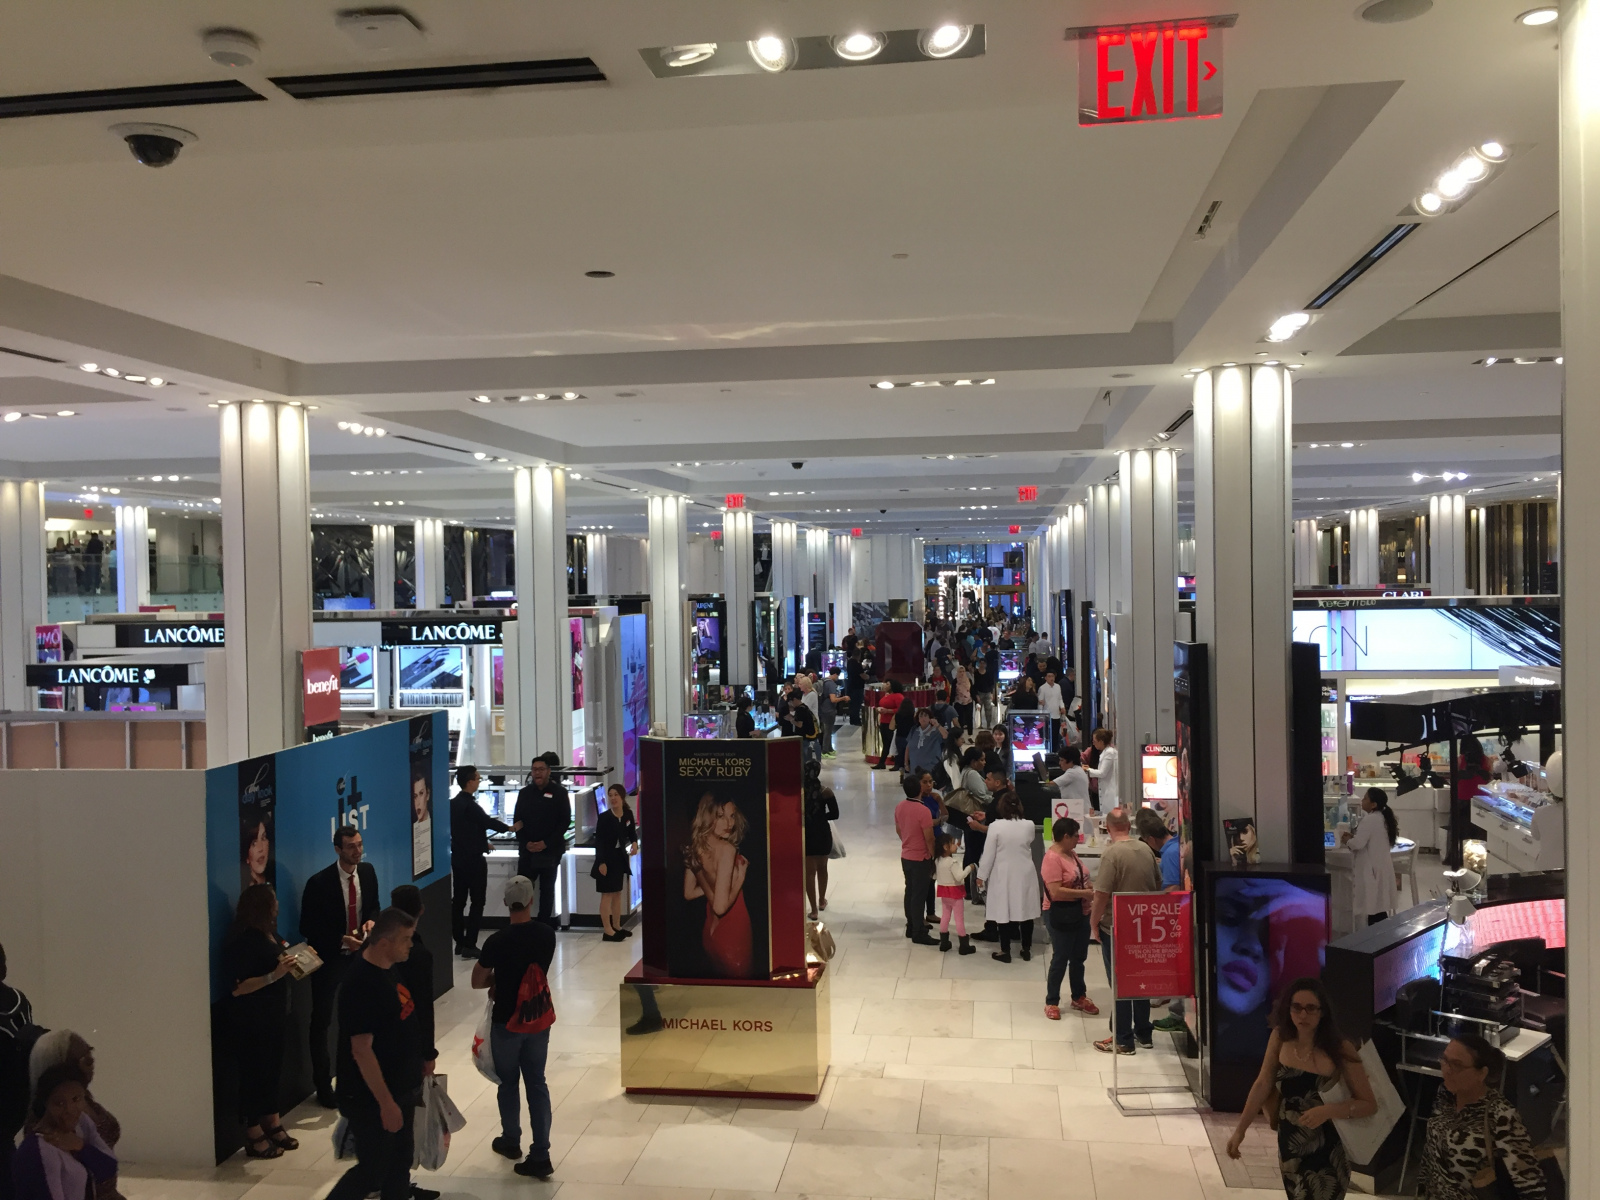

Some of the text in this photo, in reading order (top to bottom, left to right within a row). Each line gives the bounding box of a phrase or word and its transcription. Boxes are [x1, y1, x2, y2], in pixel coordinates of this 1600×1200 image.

[1097, 27, 1208, 119] EXIT
[727, 494, 744, 508] EXIT
[1019, 486, 1037, 501] EXIT
[144, 625, 225, 643] LANCÔME
[411, 622, 496, 641] LANCÔME
[57, 665, 139, 684] LANCÔME
[306, 674, 339, 695] benefit
[1145, 745, 1176, 753] CLINIQUE
[679, 757, 752, 766] MICHAEL KORS
[679, 766, 751, 776] SEXY RUBY
[331, 804, 369, 843] LIST
[1128, 902, 1182, 916] VIP SALE
[662, 1018, 773, 1032] MICHAEL KORS
